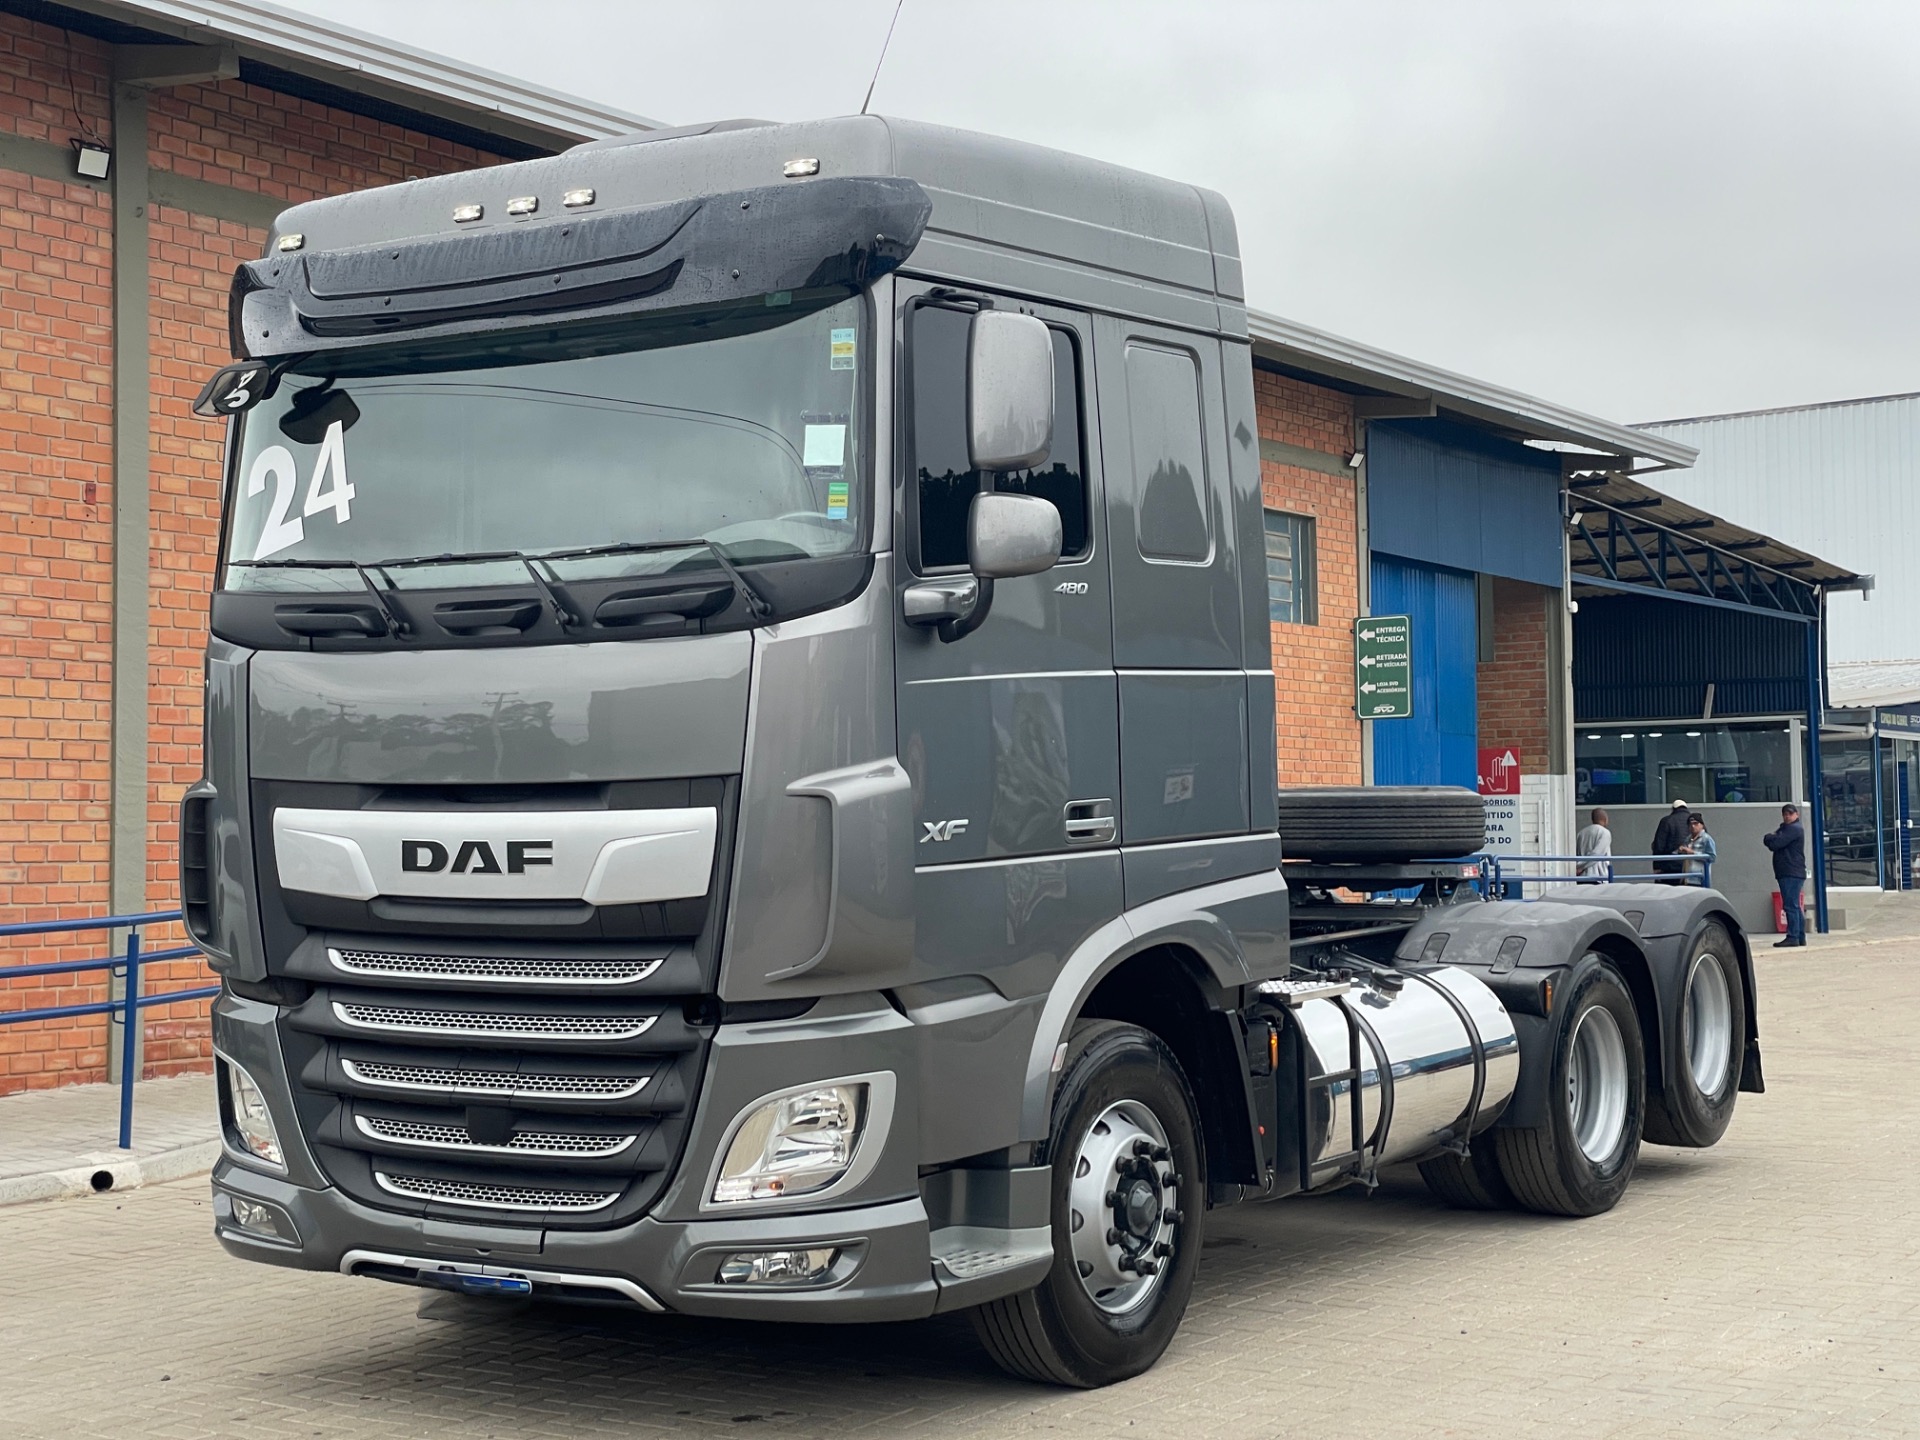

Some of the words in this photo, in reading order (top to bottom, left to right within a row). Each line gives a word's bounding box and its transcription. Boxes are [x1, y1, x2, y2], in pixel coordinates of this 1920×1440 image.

[248, 419, 356, 561] 24
[1054, 582, 1089, 594] 480
[1376, 635, 1404, 643] TÉCNICA
[1376, 653, 1407, 661] RETIRADA
[1485, 811, 1513, 819] ITIDO
[919, 819, 969, 843] XF
[1498, 836, 1512, 844] DO
[401, 838, 554, 875] DAF
